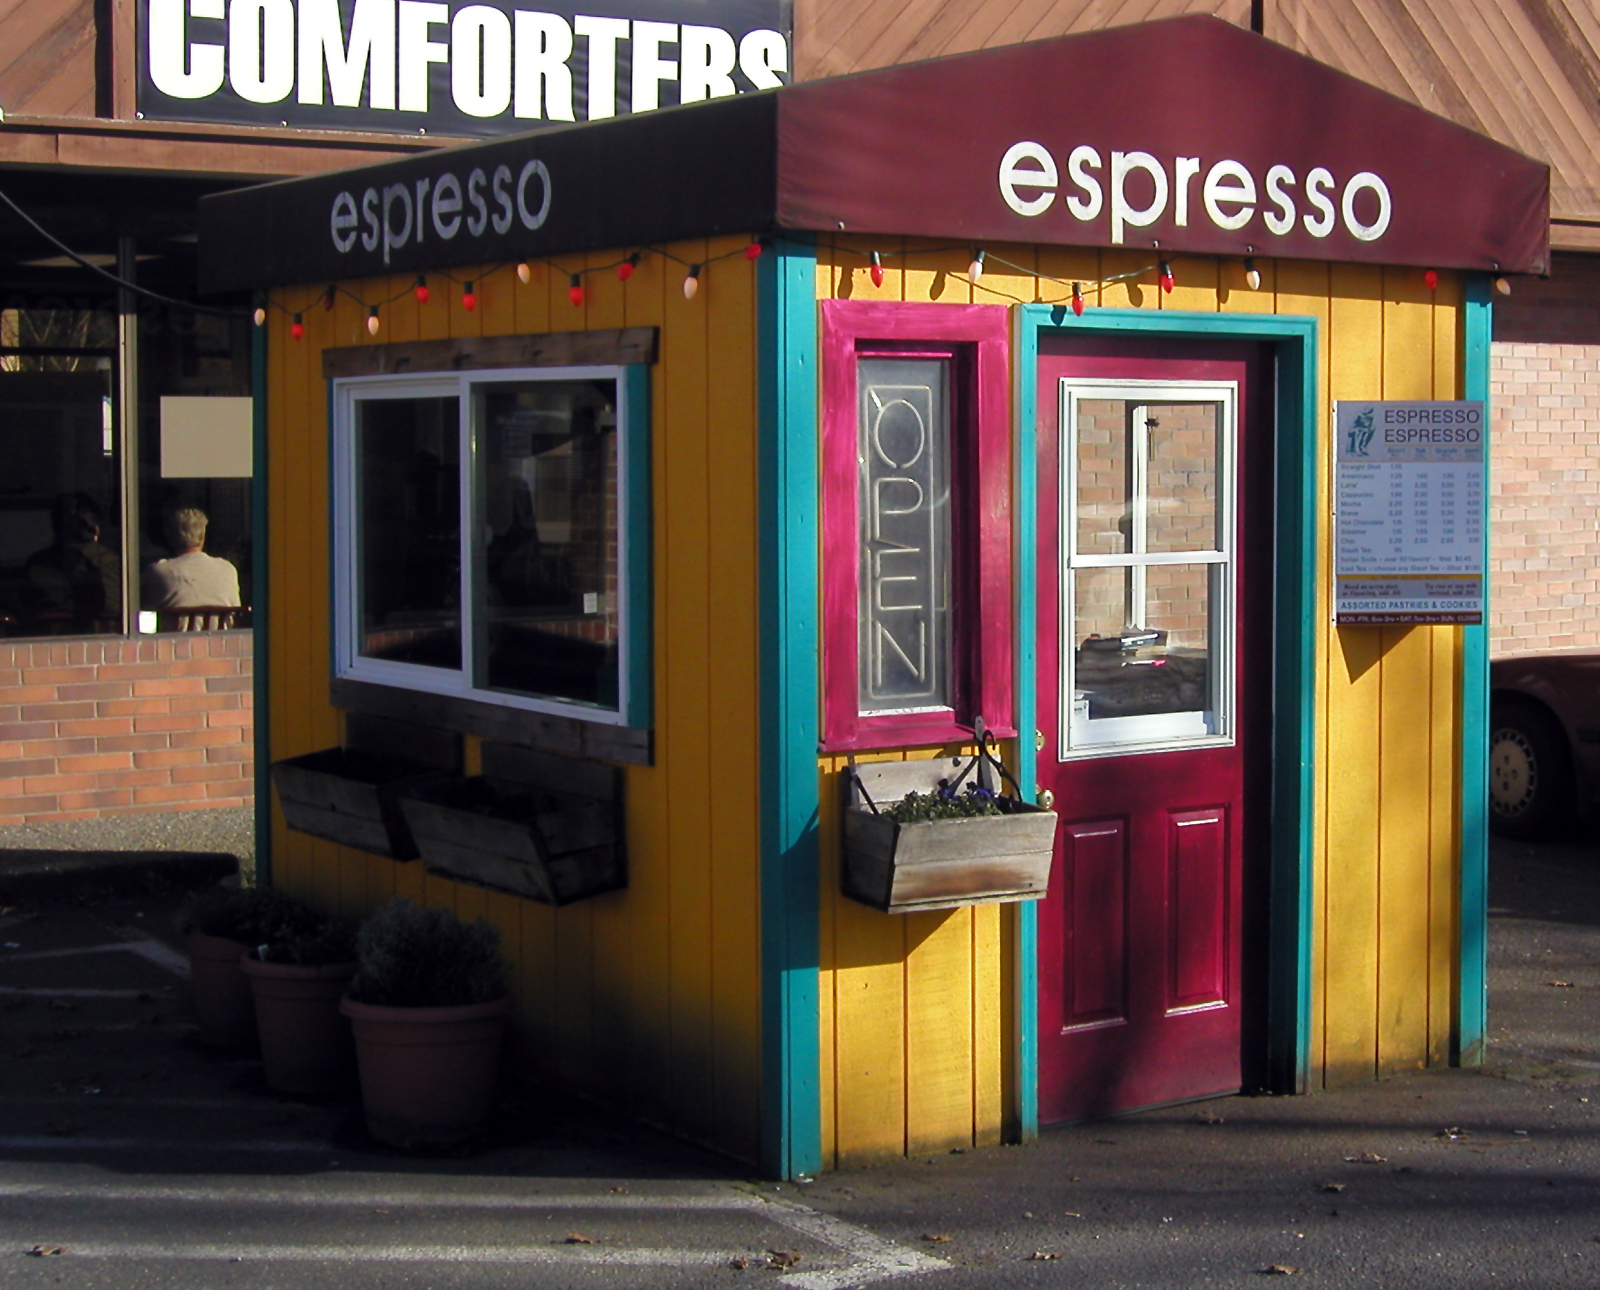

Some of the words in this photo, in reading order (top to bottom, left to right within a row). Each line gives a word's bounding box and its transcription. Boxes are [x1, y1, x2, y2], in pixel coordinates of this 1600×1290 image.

[146, 0, 788, 121] COMFORTERS
[330, 158, 552, 265] espresso
[999, 141, 1391, 245] espresso
[1384, 409, 1480, 424] ESPRESSO
[1384, 428, 1480, 443] ESPRESSO
[873, 398, 925, 688] OPEN
[1341, 601, 1386, 609] ASSORTED
[1388, 601, 1429, 609] PASTRIES
[1431, 601, 1438, 609] &
[1440, 601, 1478, 609] COOKIES
